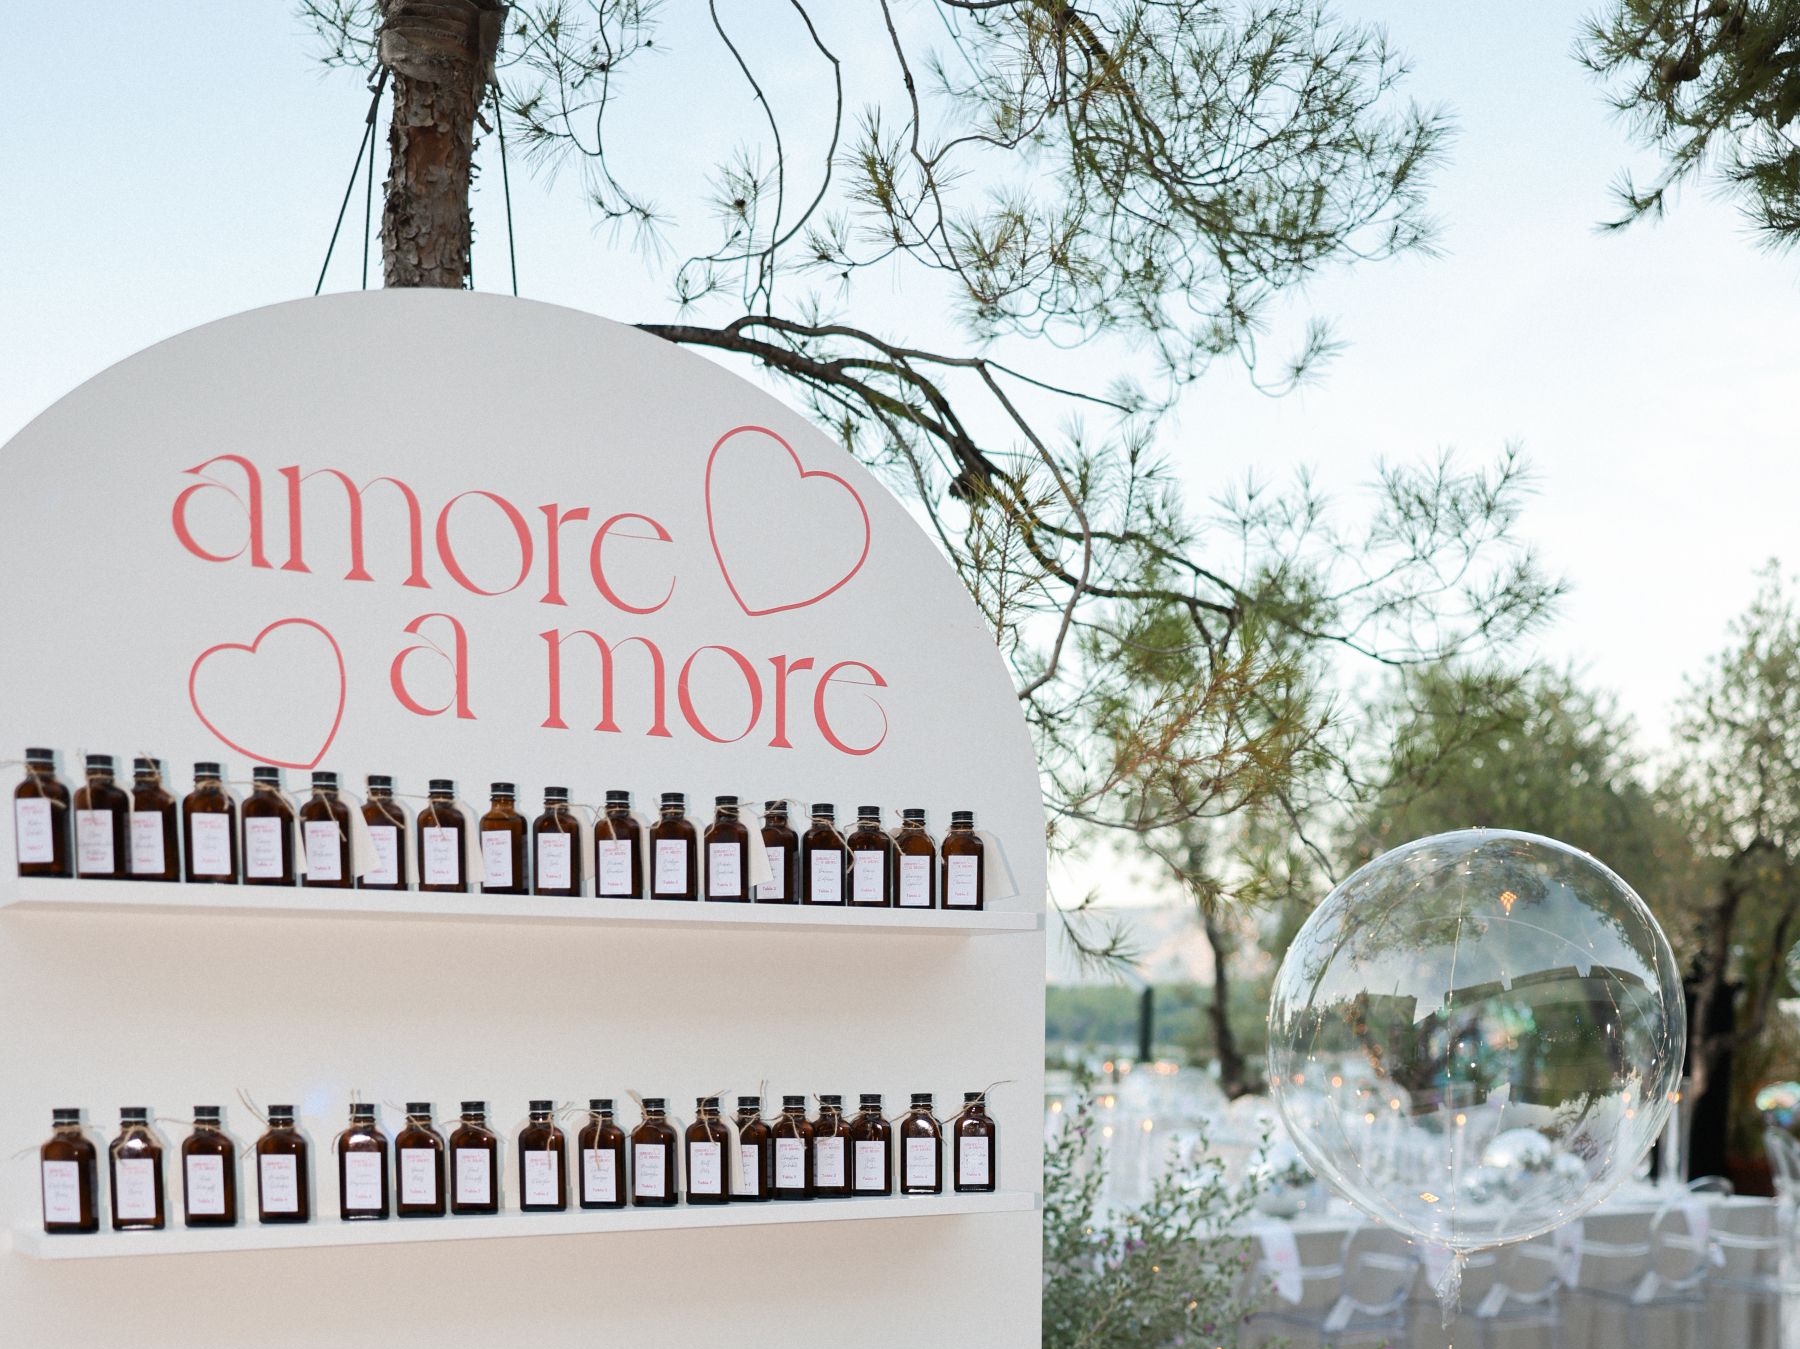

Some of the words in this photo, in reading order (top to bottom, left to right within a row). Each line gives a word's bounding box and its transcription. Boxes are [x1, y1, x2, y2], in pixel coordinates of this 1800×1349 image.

[170, 453, 676, 615] amore
[389, 612, 478, 721] a
[539, 627, 889, 757] more
